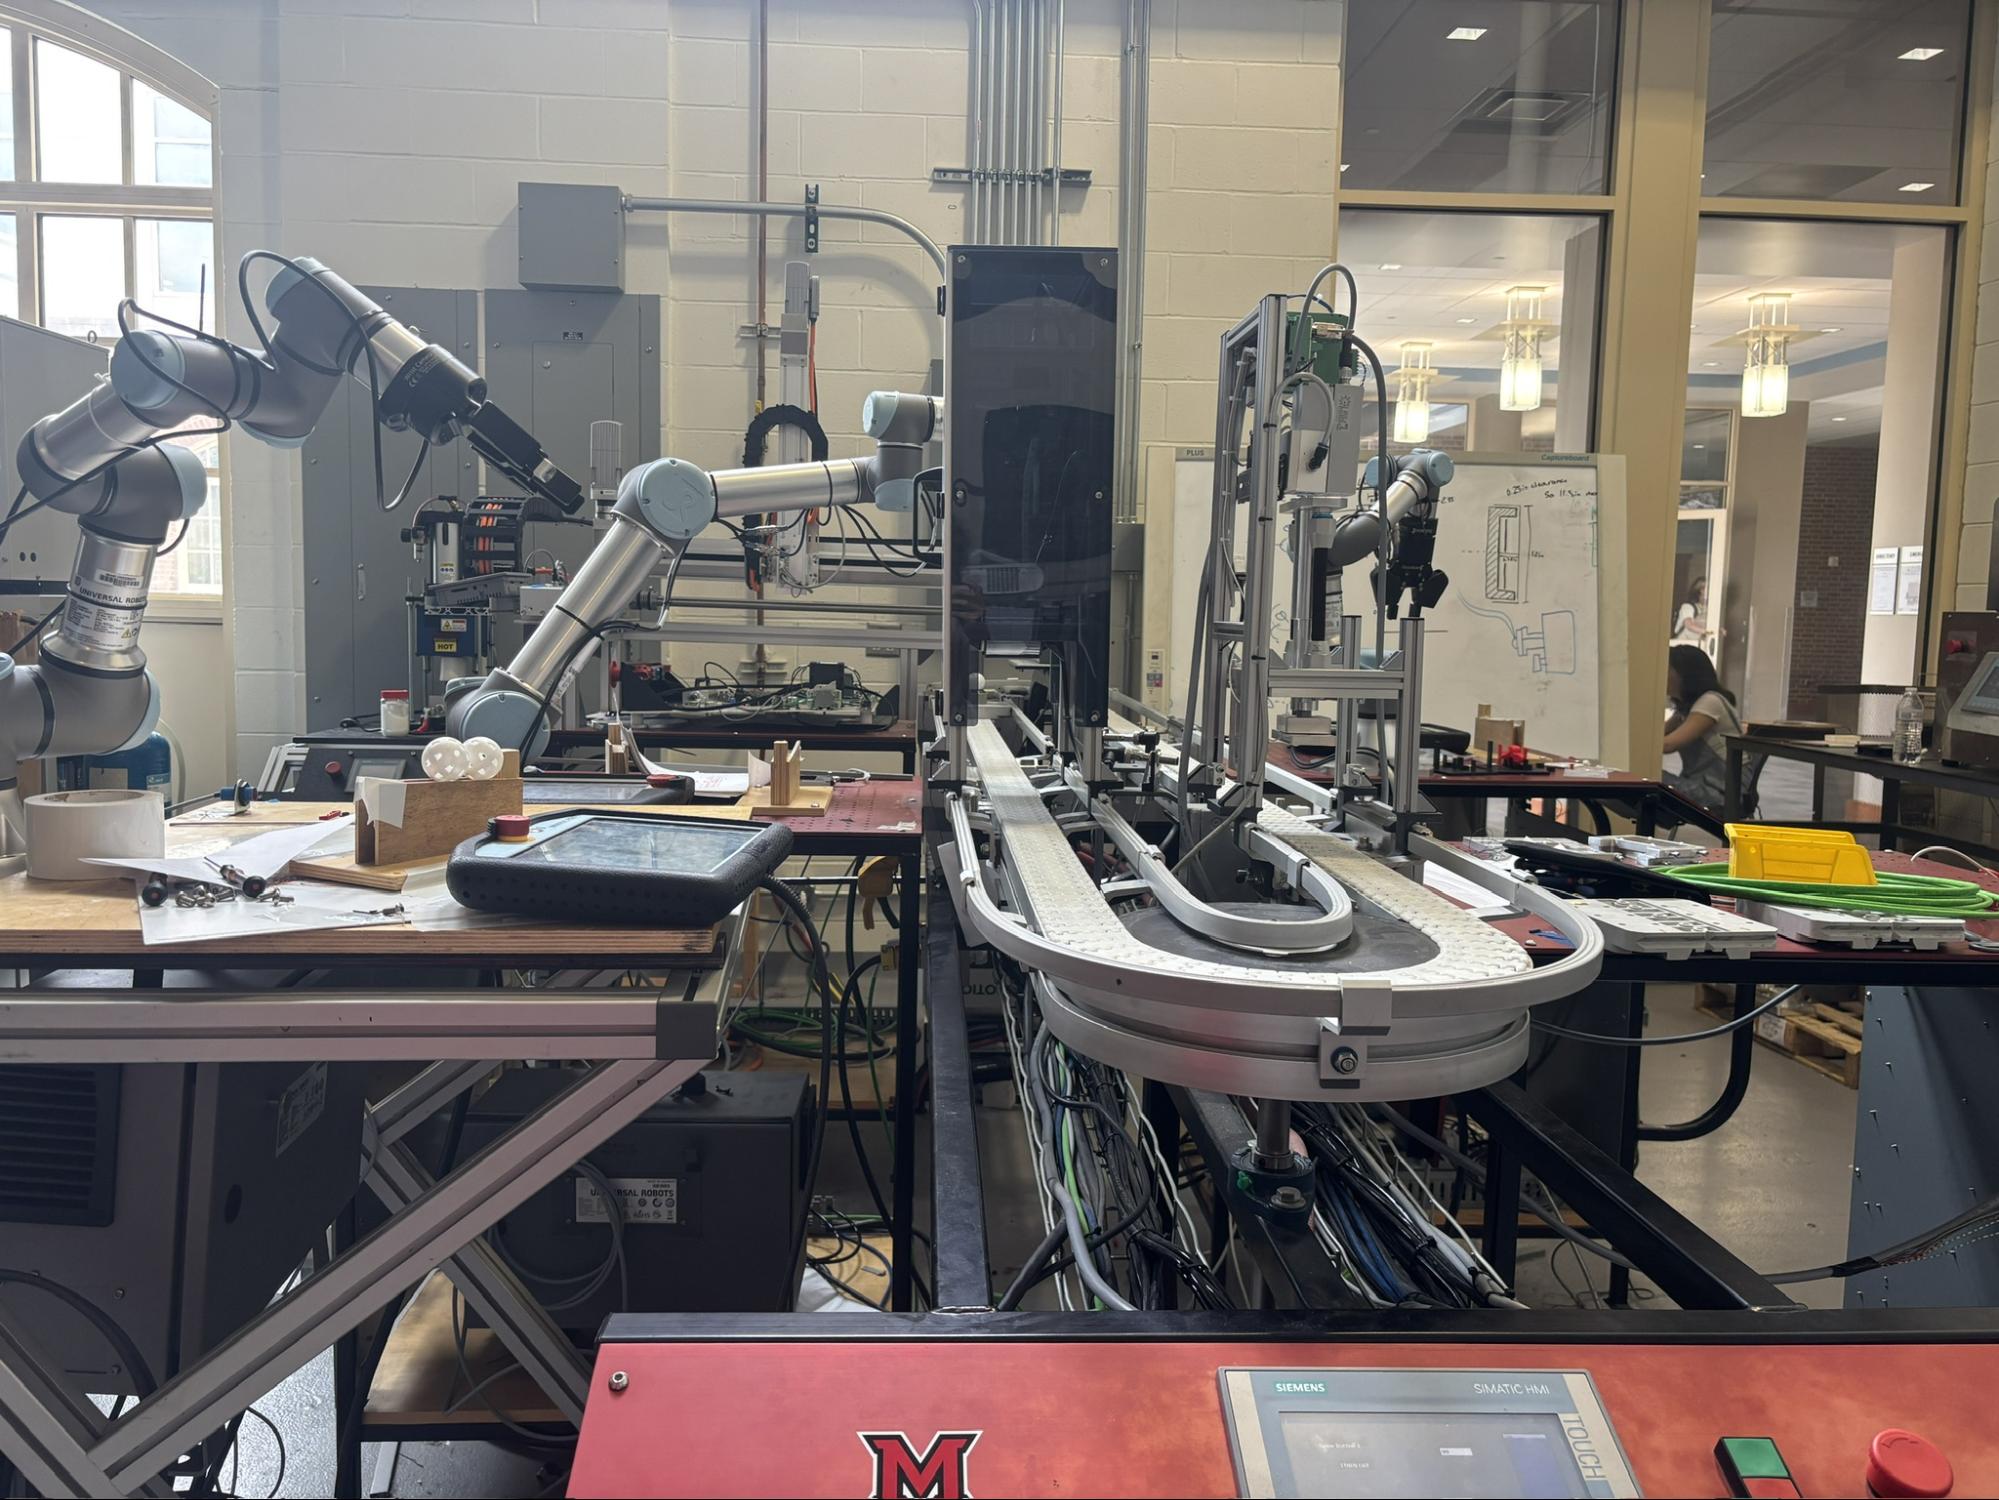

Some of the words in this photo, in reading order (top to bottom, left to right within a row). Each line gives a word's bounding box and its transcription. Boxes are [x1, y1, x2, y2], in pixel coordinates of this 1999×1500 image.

[80, 587, 123, 603] UNIVERSAL
[641, 1189, 674, 1197] ROBOTS
[1275, 1383, 1326, 1392] SIEMENS
[1473, 1383, 1523, 1394] SIMATIC
[1524, 1384, 1550, 1395] HMI
[1563, 1415, 1607, 1478] TOUCH
[856, 1430, 983, 1499] M
